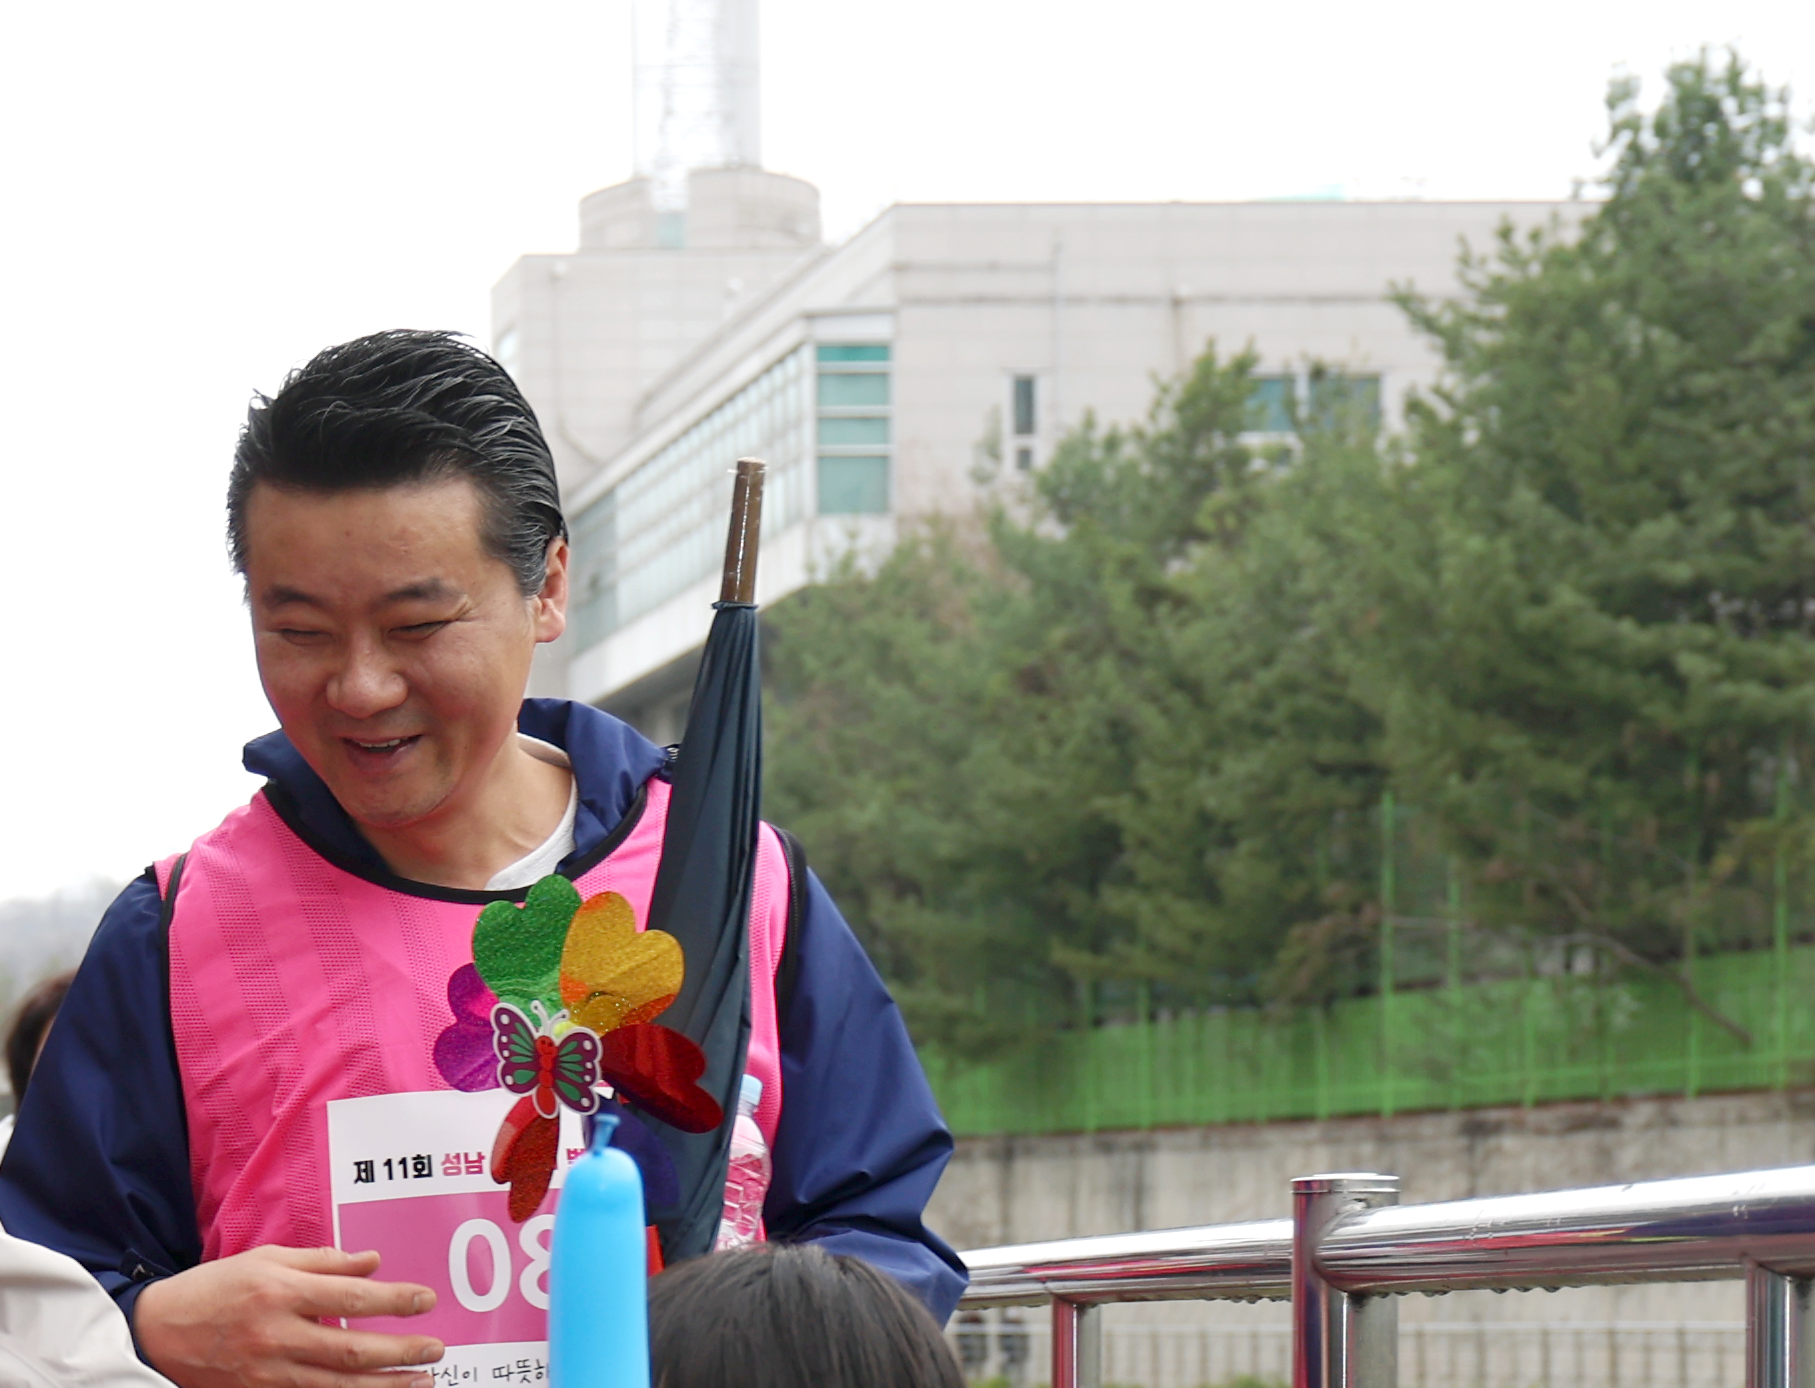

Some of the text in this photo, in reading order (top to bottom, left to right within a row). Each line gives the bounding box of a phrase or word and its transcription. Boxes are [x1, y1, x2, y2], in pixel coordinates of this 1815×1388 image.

[353, 1151, 485, 1185] 제 11회 성남
